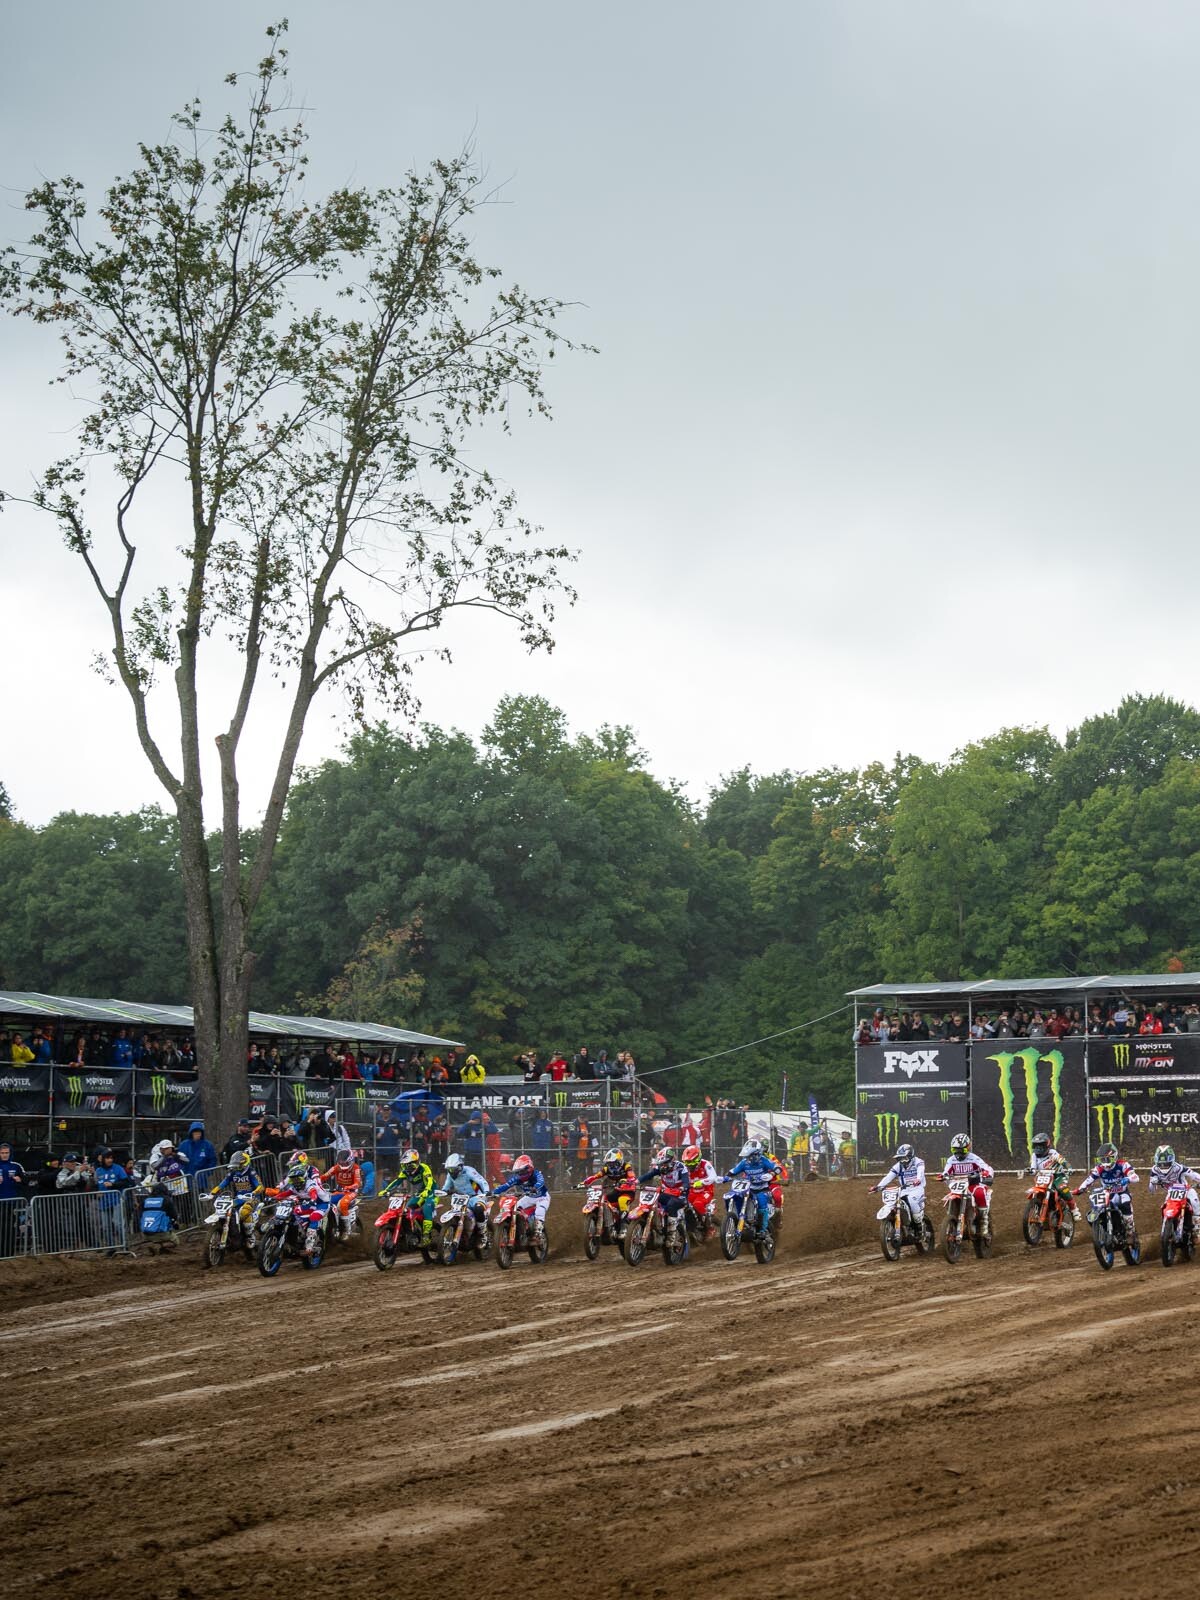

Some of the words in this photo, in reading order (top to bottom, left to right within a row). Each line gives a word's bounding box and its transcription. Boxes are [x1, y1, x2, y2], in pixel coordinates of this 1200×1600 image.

[884, 1050, 939, 1078] FOX
[900, 1119, 950, 1128] MONSTER
[1129, 1112, 1199, 1125] MONSTER
[734, 1181, 748, 1190] 21
[951, 1182, 966, 1192] 45
[1092, 1193, 1106, 1204] 15
[1169, 1190, 1186, 1200] 103
[216, 1201, 232, 1210] 57
[453, 1196, 466, 1206] 18
